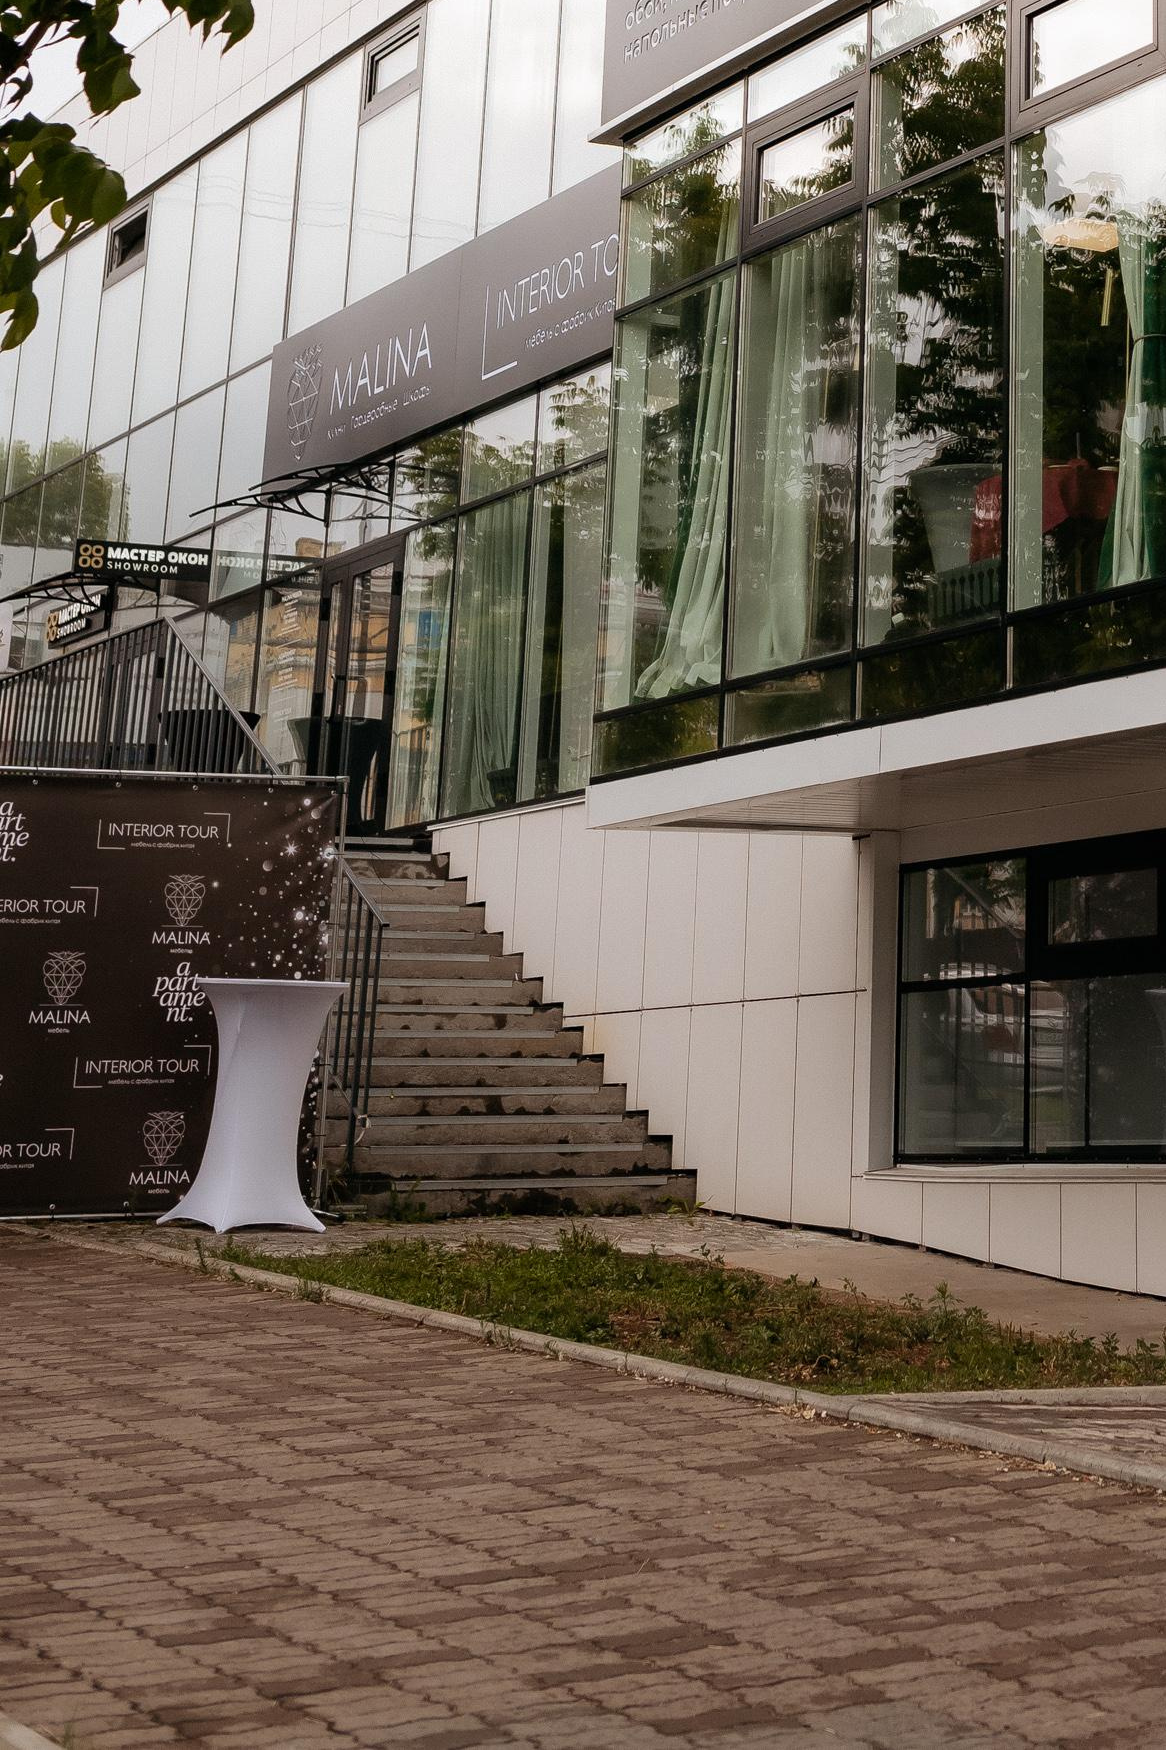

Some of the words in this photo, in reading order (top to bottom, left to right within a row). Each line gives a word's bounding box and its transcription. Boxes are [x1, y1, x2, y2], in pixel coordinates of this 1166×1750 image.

[624, 0, 708, 64] напольные
[497, 251, 584, 329] INTERIOR
[329, 322, 432, 416] MALINA
[107, 546, 165, 562] МАСТЕР
[168, 551, 208, 566] ОКОН
[107, 561, 178, 575] SHOWROOM
[108, 822, 175, 838] INTERIOR
[178, 825, 219, 839] TOUR
[43, 899, 86, 914] TOUR
[152, 931, 211, 945] MALINA
[177, 961, 190, 976] a
[152, 973, 201, 997] part
[160, 991, 206, 1007] ame
[28, 1009, 91, 1024] MALINA
[166, 1004, 193, 1022] nt.
[85, 1059, 154, 1074] INTERIOR
[157, 1059, 200, 1073] TOUR
[16, 1143, 61, 1158] TOUR
[129, 1170, 190, 1185] MALINA
